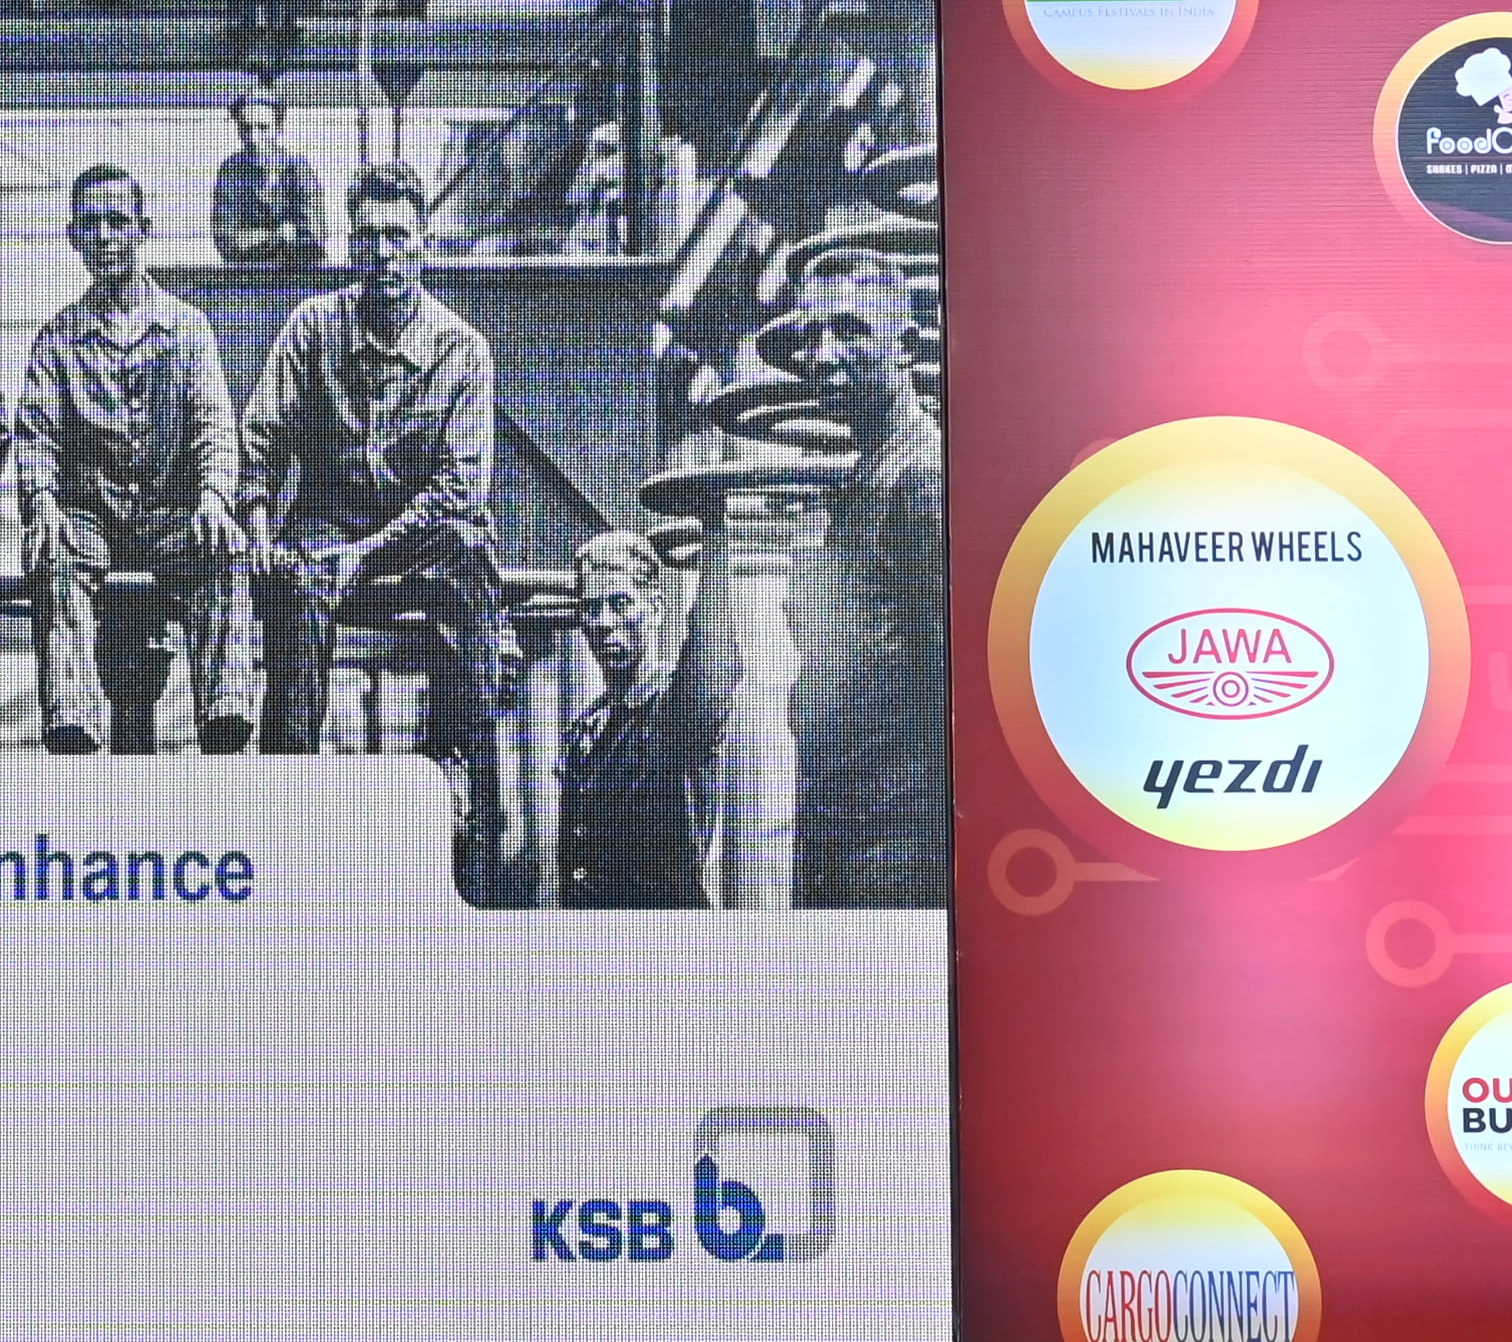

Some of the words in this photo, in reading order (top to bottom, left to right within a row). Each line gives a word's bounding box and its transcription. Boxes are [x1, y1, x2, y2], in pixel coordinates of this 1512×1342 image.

[1091, 532, 1244, 564] MAHAVEER
[1251, 531, 1362, 561] WHEELS
[1167, 628, 1293, 666] JAWA
[532, 1199, 674, 1262] KSB
